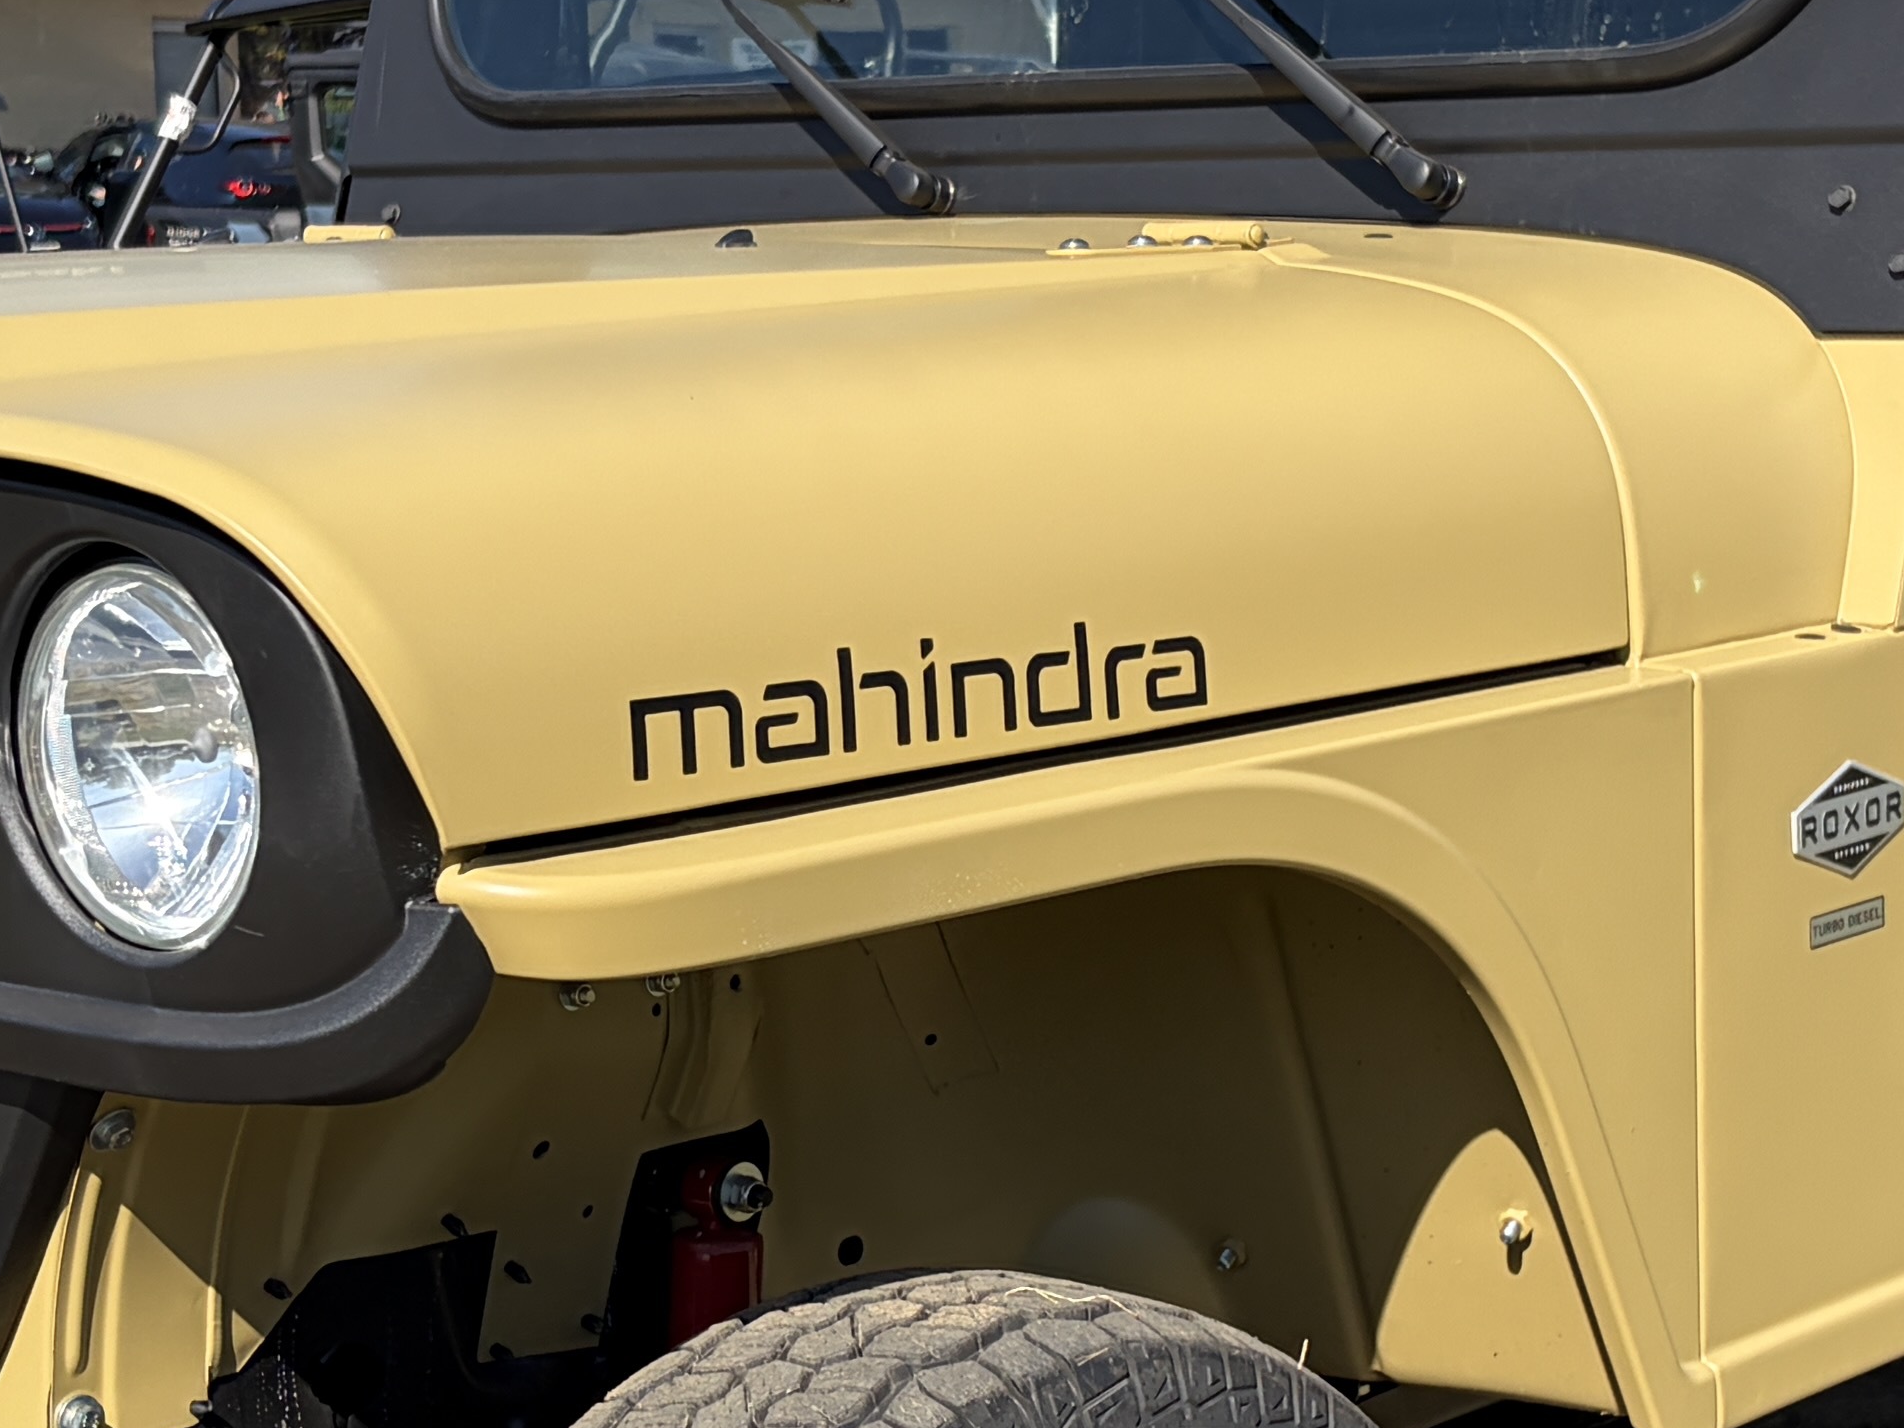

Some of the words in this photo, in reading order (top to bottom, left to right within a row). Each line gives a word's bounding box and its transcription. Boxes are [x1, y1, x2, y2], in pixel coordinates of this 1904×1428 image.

[628, 621, 1209, 782] mahindra
[1800, 790, 1903, 849] ROXOR
[1812, 917, 1845, 940] TURBO
[1847, 907, 1882, 929] DIESEL
